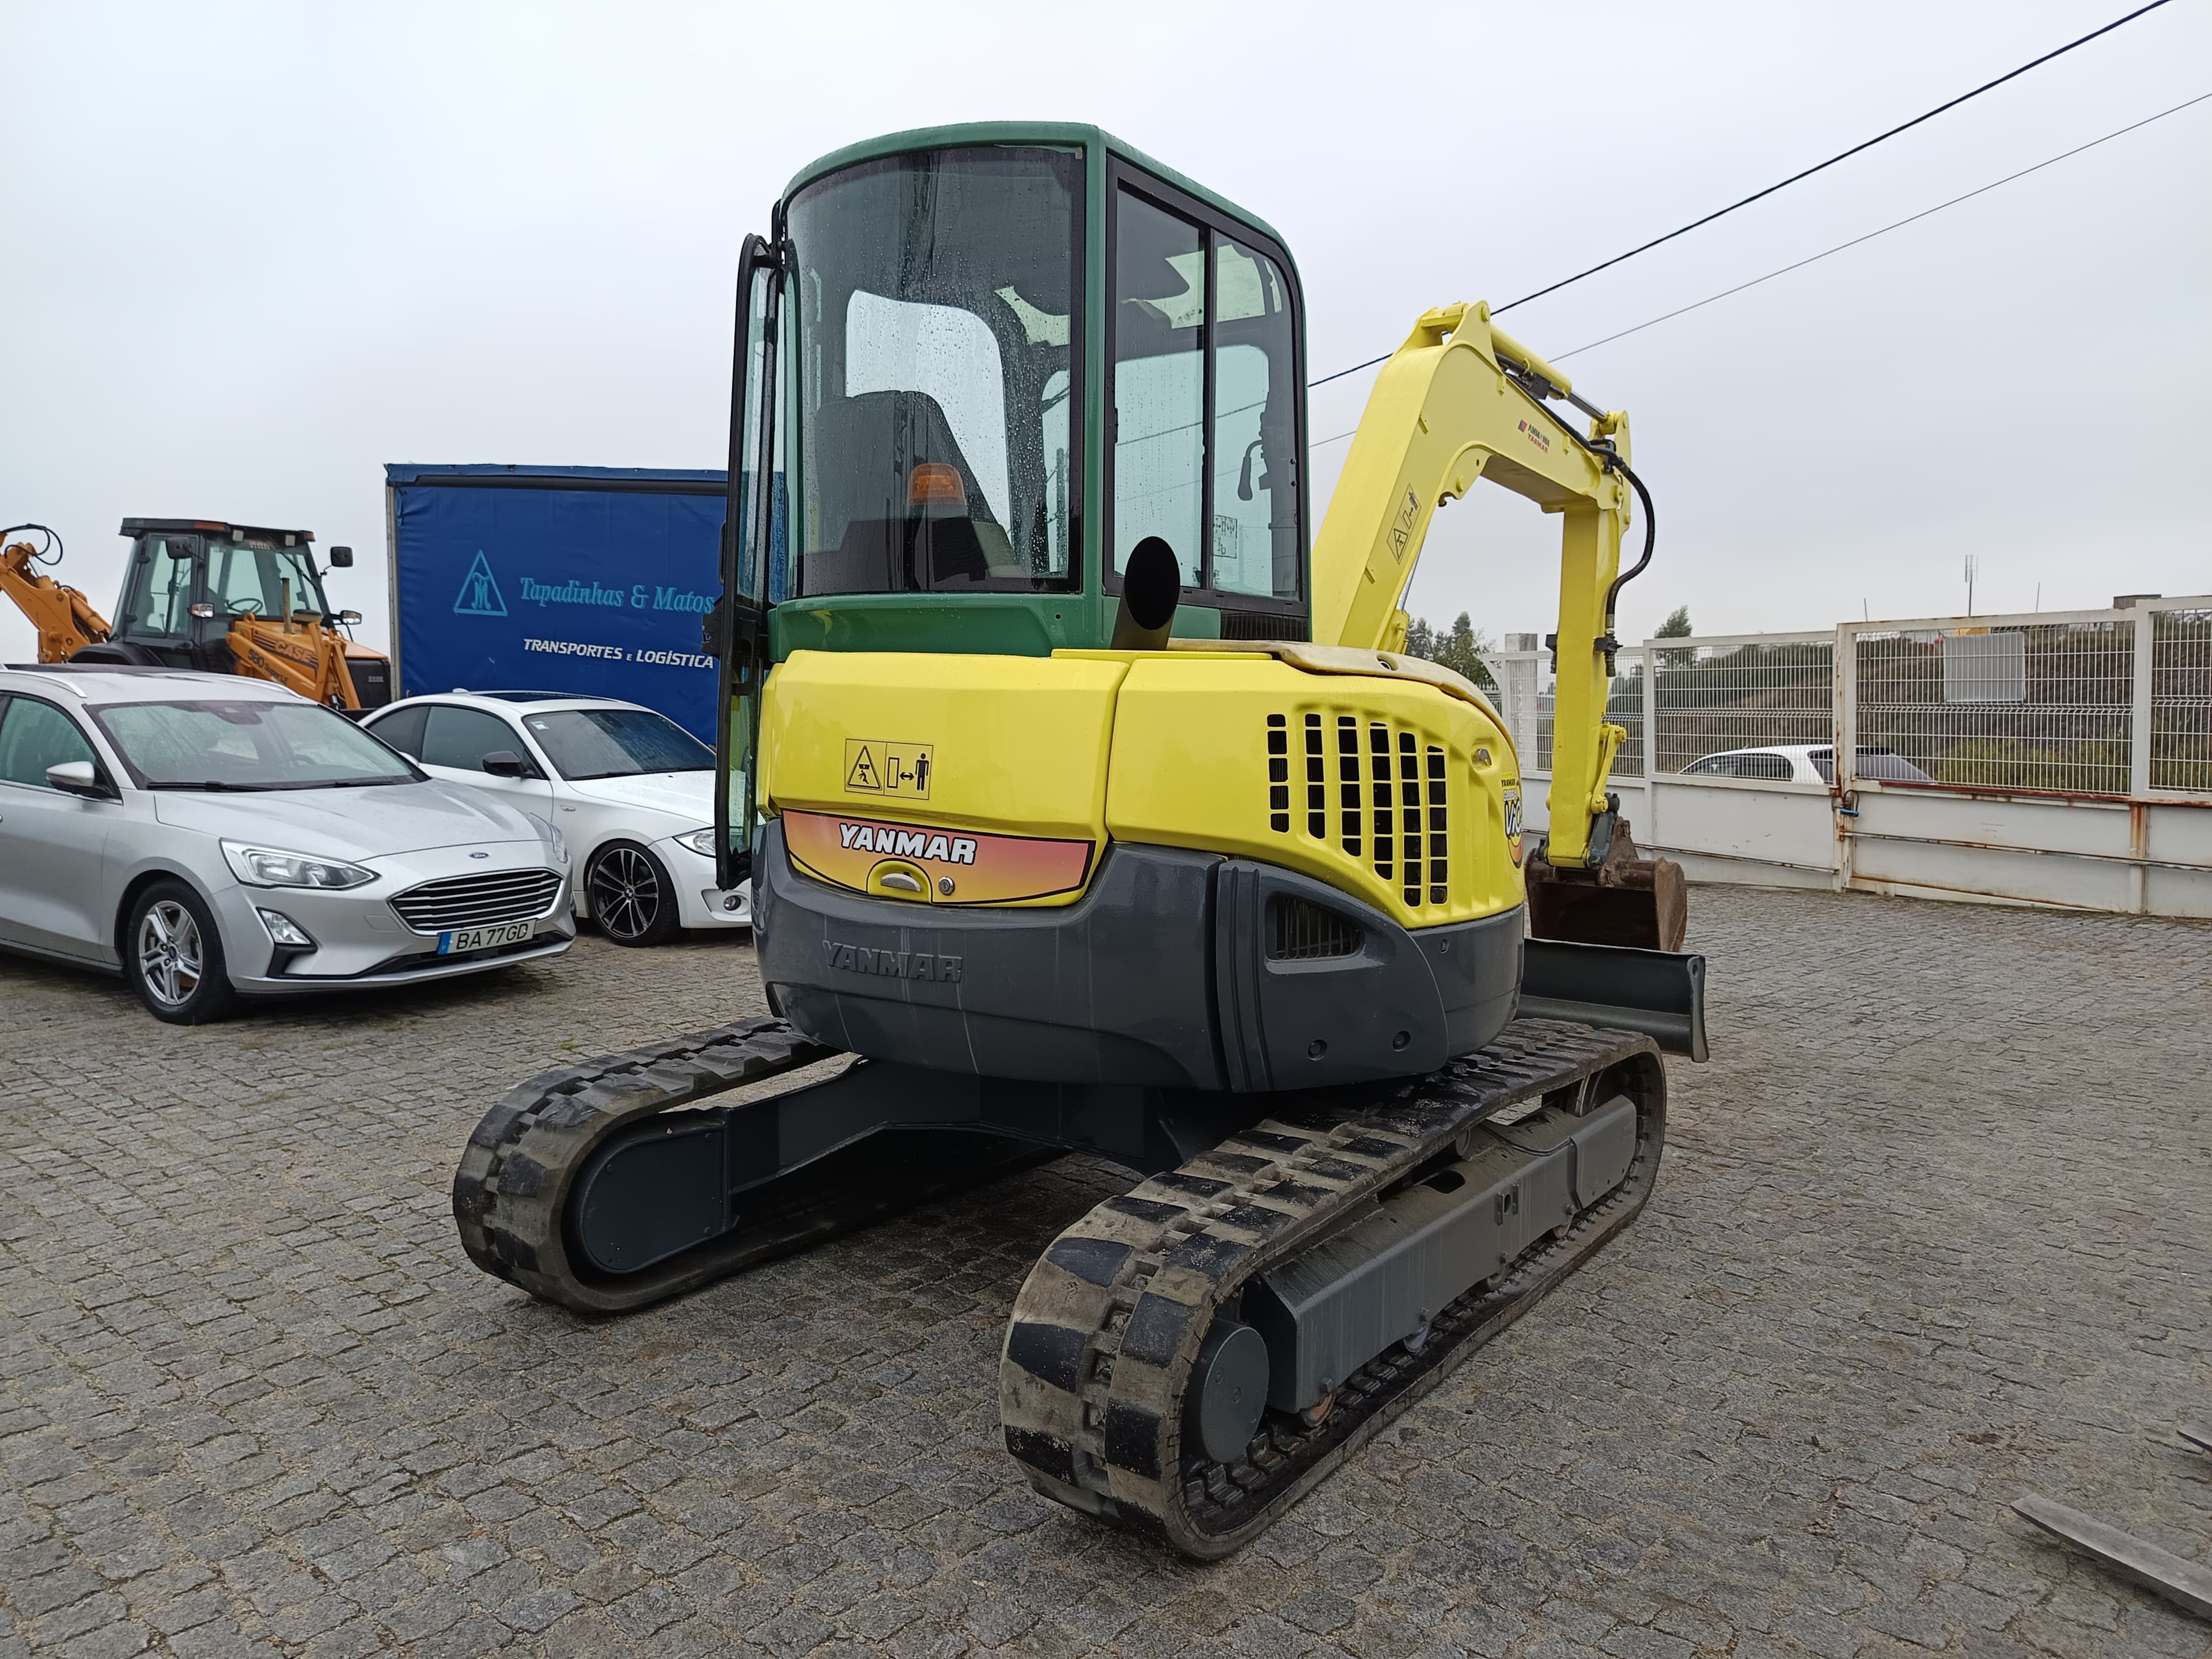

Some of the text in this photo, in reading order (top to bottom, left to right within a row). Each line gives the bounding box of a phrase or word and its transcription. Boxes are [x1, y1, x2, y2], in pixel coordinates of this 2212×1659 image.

[1528, 433, 1548, 454] YANMAR
[521, 577, 715, 614] Tapadinhas & Matos
[248, 648, 264, 667] 580
[275, 639, 313, 662] CASE
[524, 638, 623, 660] TRANSPORTES
[636, 650, 714, 669] LOGÍSTICA
[840, 823, 978, 865] YANMAR
[823, 940, 963, 982] YANMAR
